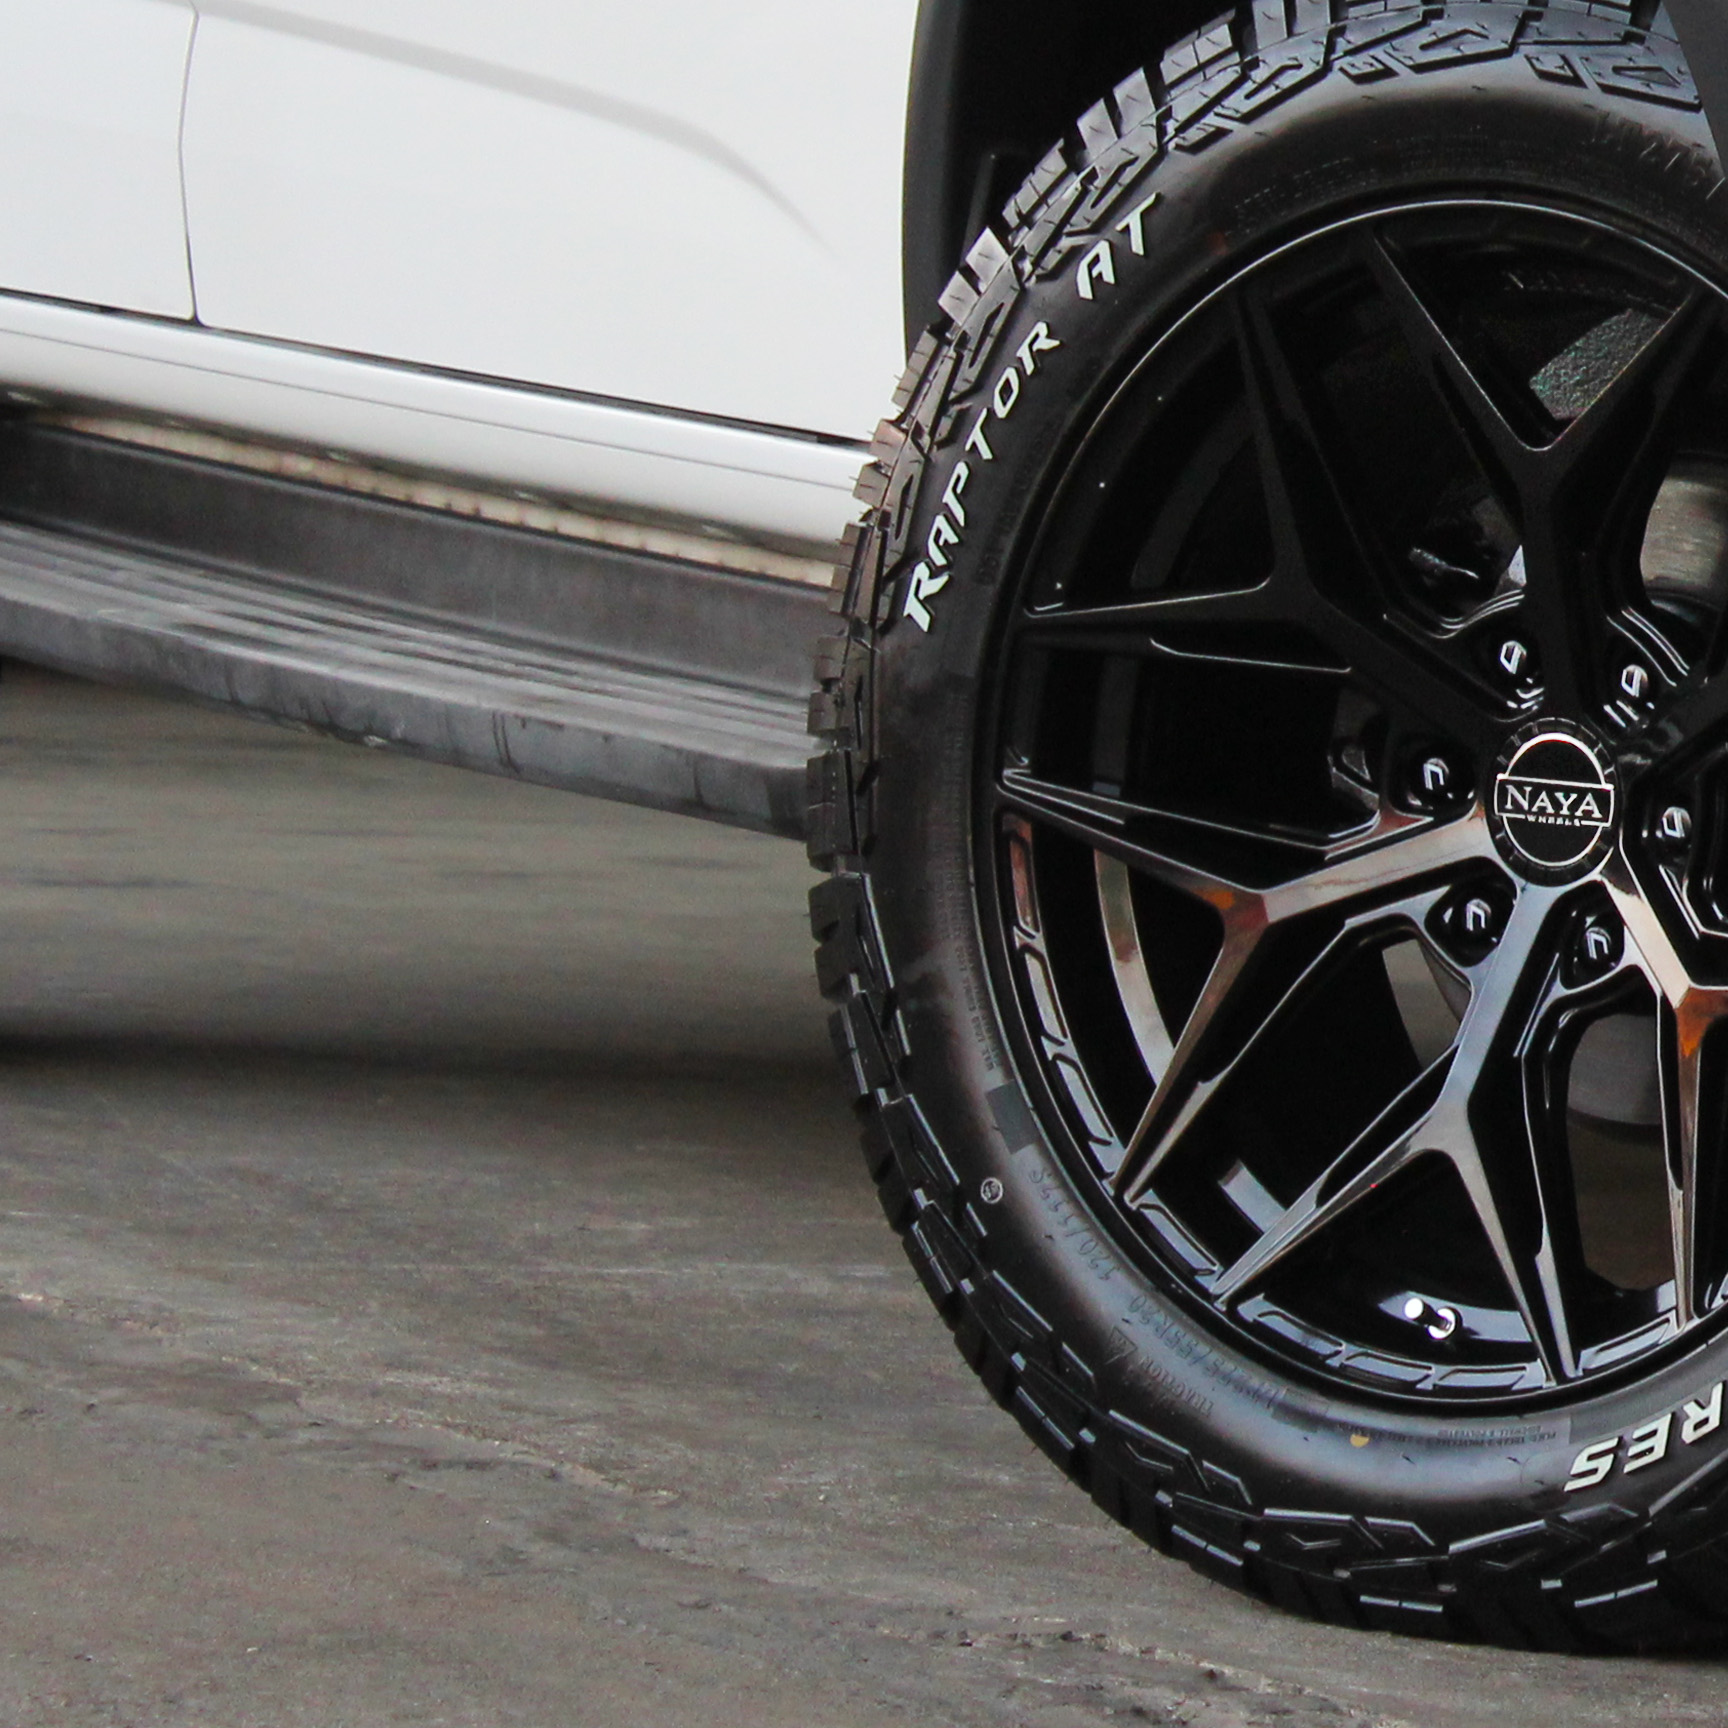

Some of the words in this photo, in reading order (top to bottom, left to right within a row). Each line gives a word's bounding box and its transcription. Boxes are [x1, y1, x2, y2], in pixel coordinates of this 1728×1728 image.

[1076, 193, 1161, 300] AT
[904, 321, 1060, 632] RAPTOR
[1505, 784, 1603, 819] NAYA
